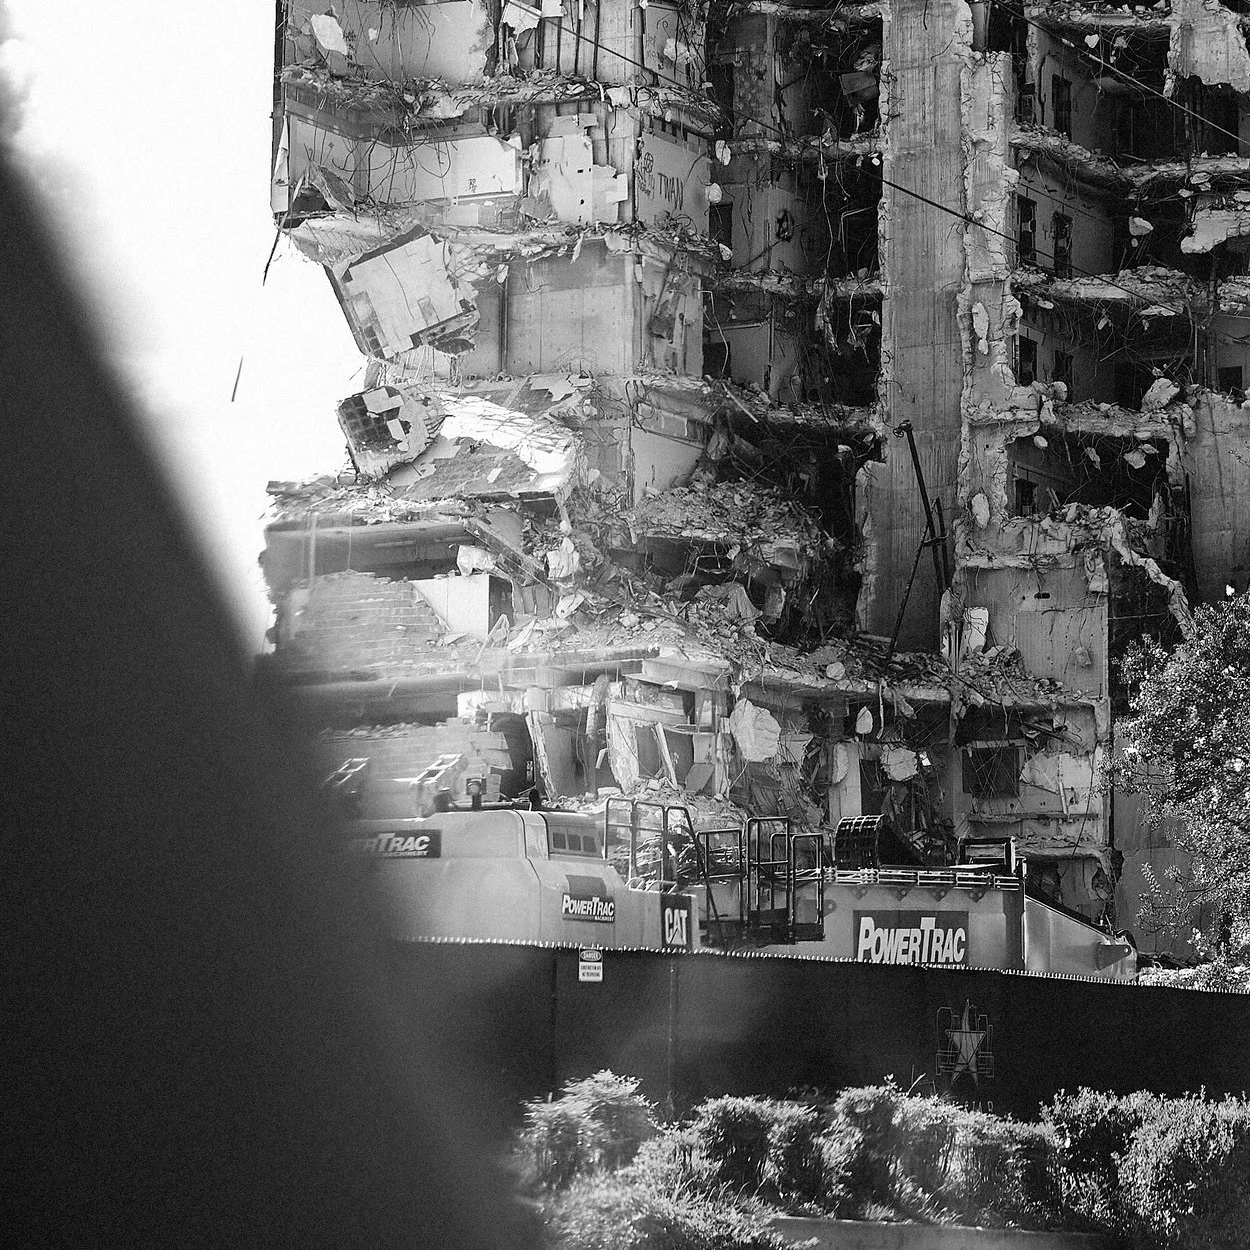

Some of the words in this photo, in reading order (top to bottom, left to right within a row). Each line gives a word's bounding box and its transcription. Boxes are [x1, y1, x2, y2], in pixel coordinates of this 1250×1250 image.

[562, 894, 615, 916] POWERTRAC
[665, 907, 688, 945] CAT
[858, 916, 966, 963] POWERTRAC
